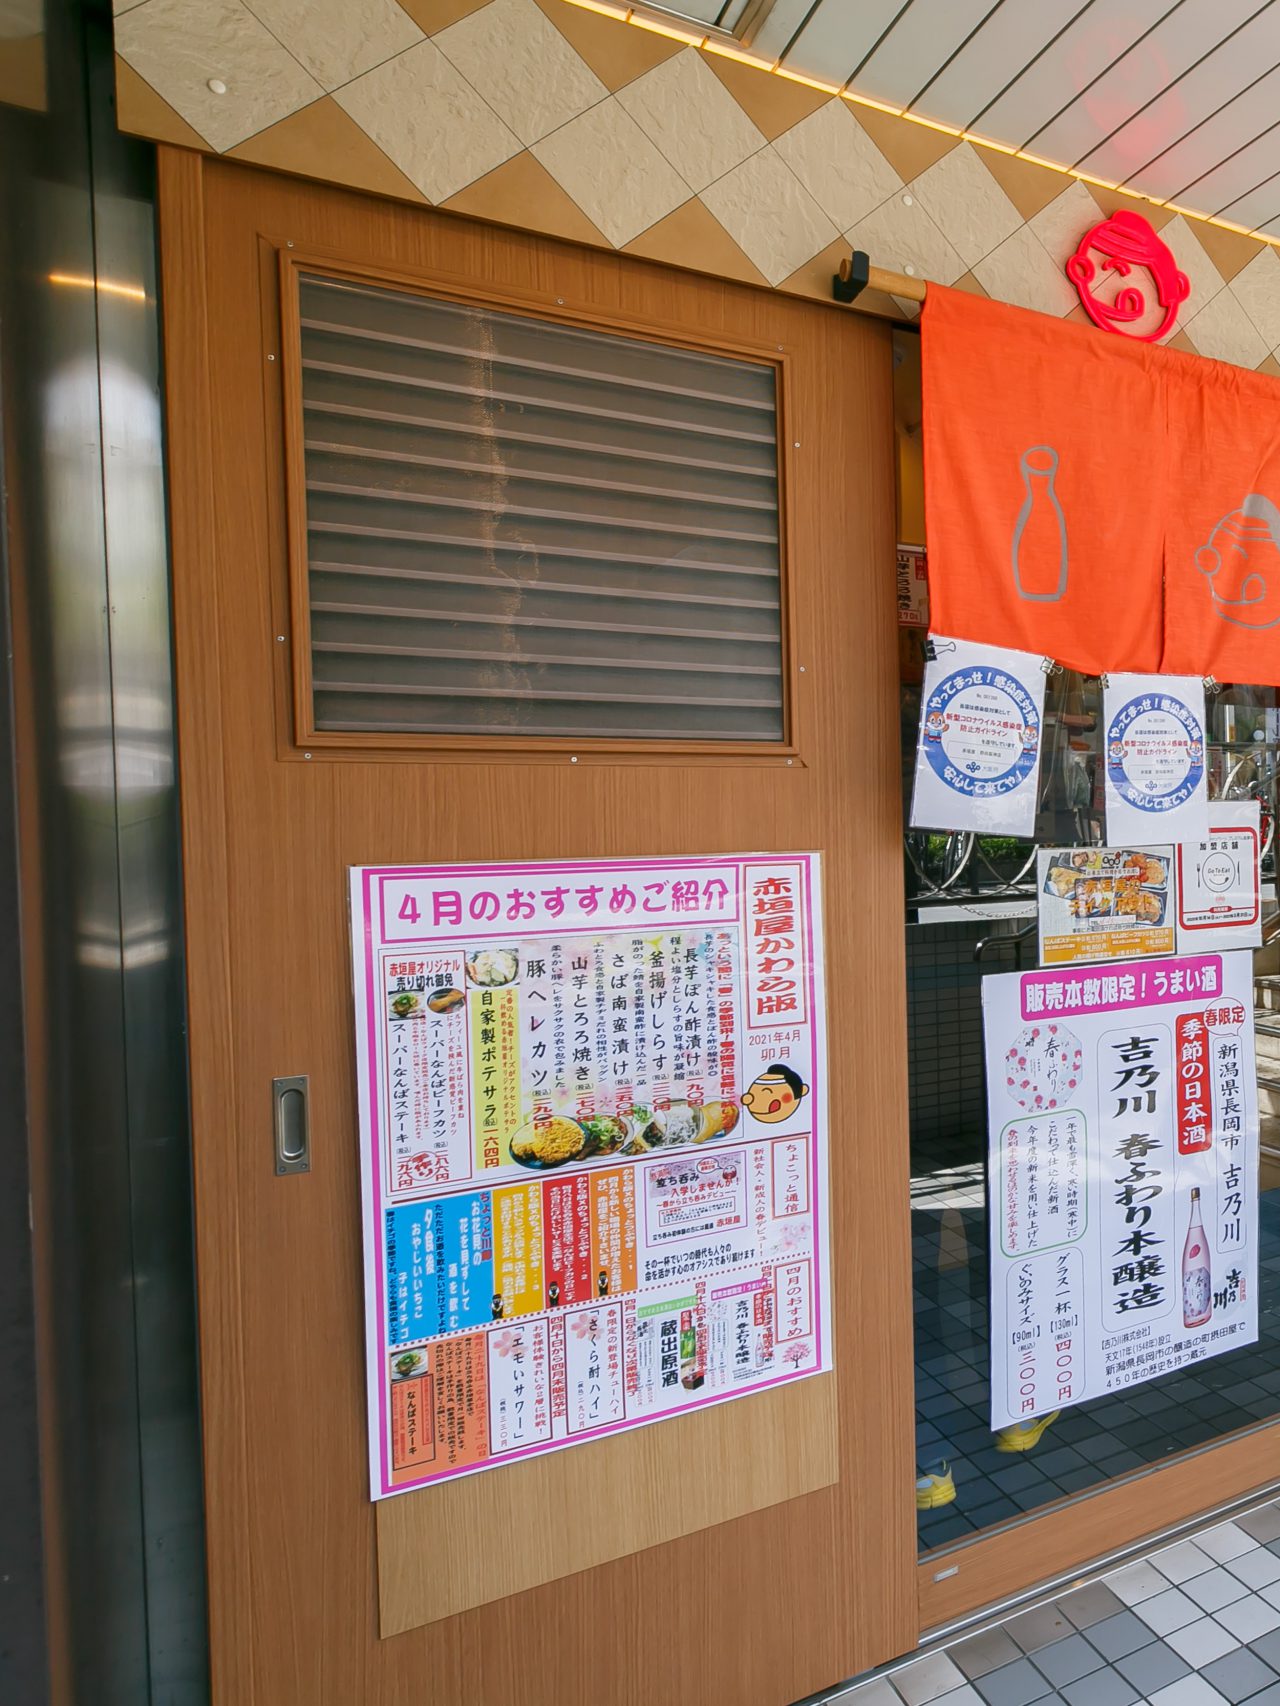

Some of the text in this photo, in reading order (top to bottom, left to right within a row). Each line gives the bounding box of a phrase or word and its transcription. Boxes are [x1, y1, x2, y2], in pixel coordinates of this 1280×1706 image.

[946, 713, 1022, 730] 新型コロナウイルス感染症
[959, 724, 1008, 737] 防止ガイドライン
[1199, 841, 1239, 850] 加盟店舗
[398, 878, 729, 926] 4月のおすすめご紹介
[389, 959, 460, 976] 赤垣屋オリジナル
[752, 877, 798, 1015] 赤垣屋かわら版
[397, 972, 454, 991] 売り切れ御免
[649, 951, 667, 1071] 釜揚げしらす
[670, 936, 685, 1081] 程よい塩分としらすの旨味が凝縮
[684, 948, 702, 1067] 長芋ぽん酢漬け
[1025, 965, 1217, 1013] 販売本数限定！うまい酒
[526, 959, 547, 1087] 豚ヘレカツ
[551, 945, 566, 1088] 柔らかい豚ヘレをサクサクの衣で包みました
[572, 956, 592, 1081] 山芋とろろ焼き
[611, 954, 629, 1076] さば南蛮漬け
[749, 1029, 801, 1046] 2021年4月
[1205, 1006, 1245, 1027] 春限定
[392, 1023, 410, 1143] スーパーなんばステーキ
[430, 1019, 447, 1138] スーパーなんばビーフカツ
[480, 990, 498, 1118] 自家製ポテサラ
[761, 1046, 791, 1061] 卯月
[1181, 1020, 1207, 1146] 季節の日本酒
[532, 1098, 553, 1130] 二九〇円
[576, 1091, 595, 1123] 二七〇円
[616, 1086, 634, 1118] 二五〇円
[483, 1128, 499, 1168] 一六四円
[1047, 1120, 1059, 1215] こだわって仕込んだ新酒
[1217, 1043, 1242, 1243] 新潟県長岡市 吉乃川
[656, 1172, 700, 1188] 立ち呑み
[753, 1148, 768, 1257] 新社会人・新成人の春デビュー！
[784, 1144, 800, 1213] ちょこっと通信
[1026, 1125, 1039, 1248] 今年度の新米を用い仕上げた
[1110, 1037, 1166, 1315] 吉乃川 春ふわり本醸造
[459, 1217, 470, 1311] 花を見ずして
[471, 1201, 482, 1266] お花見の
[644, 1243, 732, 1269] その一杯でいつの時代も人々の
[644, 1249, 756, 1282] 命を活かす心のオアシスであり続けます
[449, 1263, 459, 1328] 酒を飲む
[786, 1266, 802, 1337] 四月のおすすめ
[1018, 1263, 1036, 1326] ぐいのみサイズ
[1056, 1252, 1072, 1314] グラス一杯
[1213, 1268, 1242, 1309] 吉乃川
[551, 1316, 566, 1418] 四月十日から四月末販売予定
[588, 1309, 601, 1419] 「さくら酎ハイ」
[607, 1308, 620, 1414] 春限定の新登場チューハイ
[660, 1319, 679, 1388] 蔵出原酒
[1056, 1339, 1073, 1400] 四〇〇円
[1101, 1326, 1151, 1350] 【吉乃川株式会社】
[1104, 1334, 1172, 1363] 天文17年(1548年)設立
[1105, 1322, 1246, 1376] 新潟県長岡市の醸造の町摂田屋で
[1106, 1346, 1208, 1388] 450年の歴史を持つ蔵元
[512, 1326, 525, 1439] 「エモいサワー」
[1018, 1352, 1036, 1413] 三〇〇円
[407, 1392, 417, 1454] なんばステーキ
